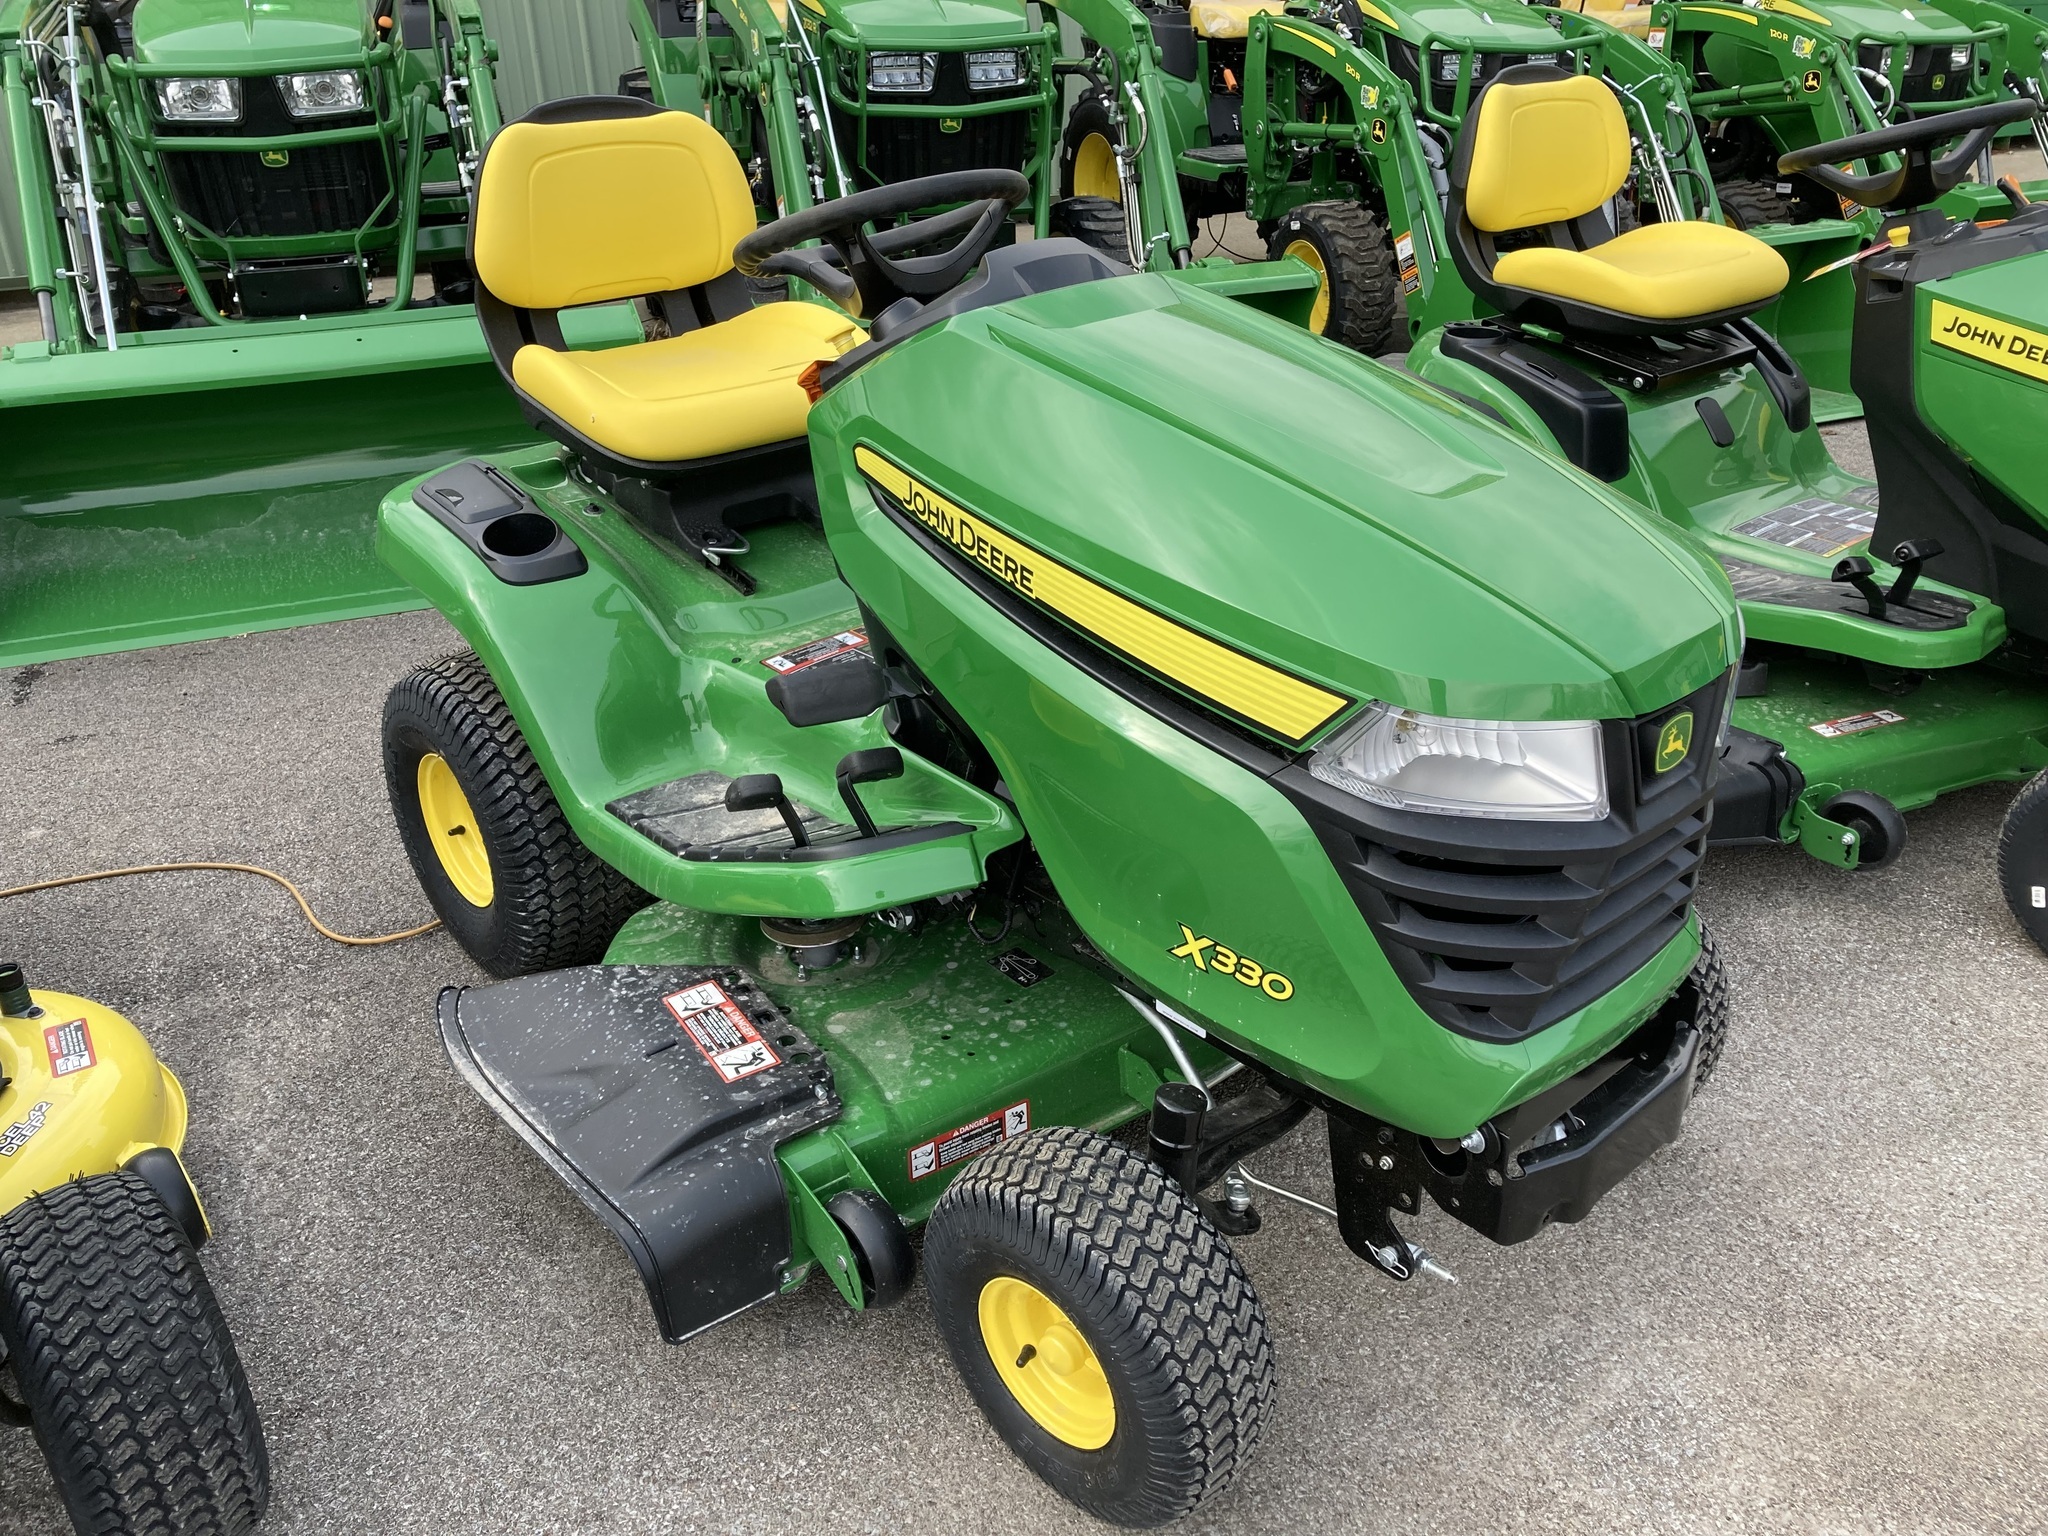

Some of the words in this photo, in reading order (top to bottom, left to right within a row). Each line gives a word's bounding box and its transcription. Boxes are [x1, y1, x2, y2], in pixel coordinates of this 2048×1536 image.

[1943, 316, 2005, 350] JOHN
[902, 480, 955, 541] JOHN
[959, 518, 1035, 595] DEERE
[1167, 921, 1295, 1001] X330
[729, 1011, 757, 1037] DANGER
[0, 1115, 46, 1157] DEEP
[959, 1117, 989, 1134] DANGER
